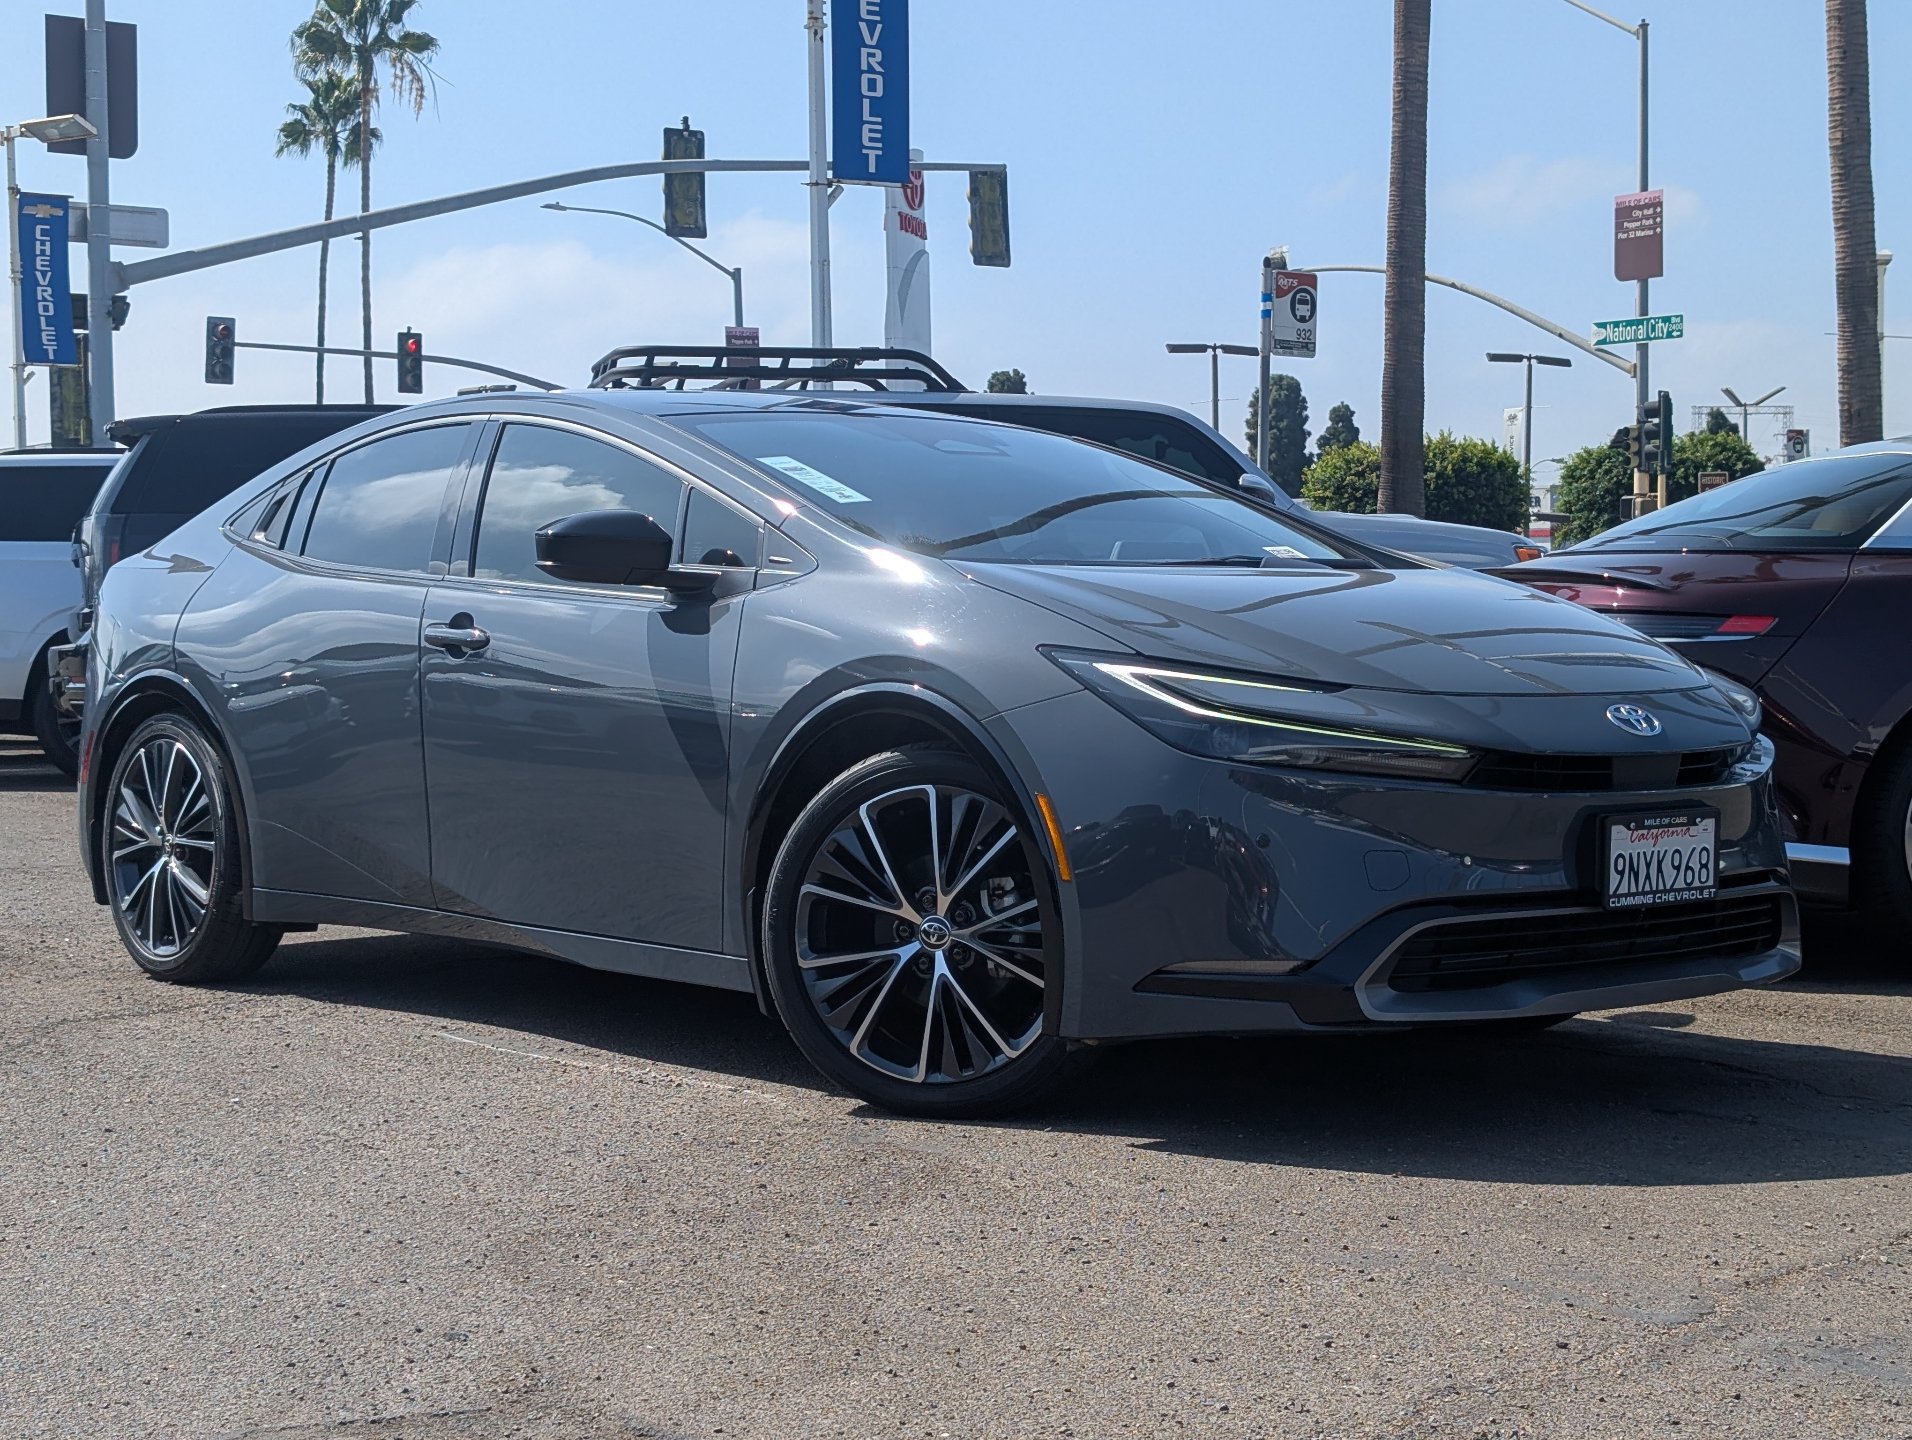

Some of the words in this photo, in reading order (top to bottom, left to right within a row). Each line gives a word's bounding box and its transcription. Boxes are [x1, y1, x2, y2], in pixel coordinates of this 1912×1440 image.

[1616, 200, 1632, 208] MILE
[1643, 195, 1661, 204] CARS
[1632, 210, 1642, 218] City
[1643, 207, 1654, 215] Hall
[1623, 221, 1641, 229] Pepper
[1642, 218, 1653, 226] Park
[1635, 229, 1654, 237] Marina
[1278, 279, 1298, 287] MTS
[35, 224, 58, 360] CHEVROLET
[1671, 316, 1681, 324] Blvd
[1606, 320, 1647, 342] National
[1648, 318, 1669, 339] City
[1668, 323, 1682, 331] 2400
[1296, 328, 1312, 341] 932
[1671, 816, 1688, 824] CARS
[1629, 826, 1699, 848] California
[1612, 846, 1711, 895] 9NXK968
[1609, 895, 1654, 907] CUMMING
[1655, 888, 1717, 903] CHEVROLET
